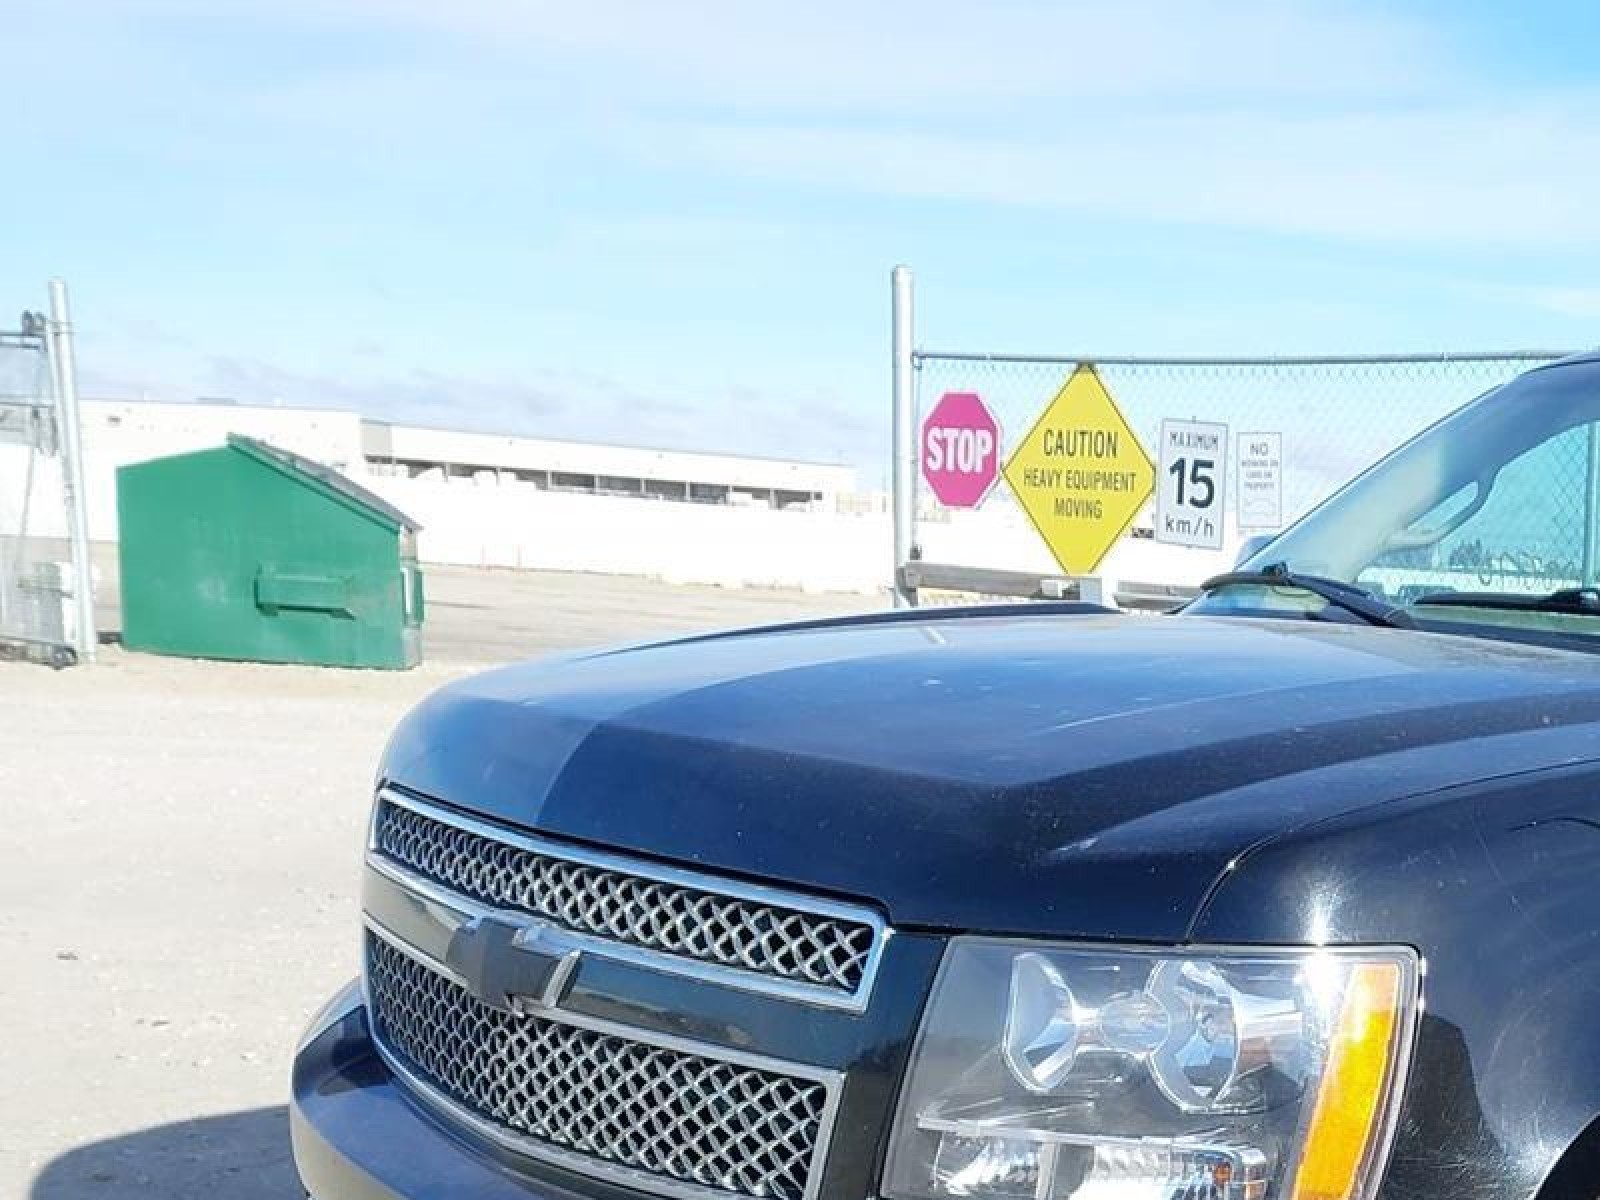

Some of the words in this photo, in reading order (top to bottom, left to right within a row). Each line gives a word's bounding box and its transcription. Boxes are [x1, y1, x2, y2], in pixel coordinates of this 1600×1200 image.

[926, 426, 993, 473] STOP
[1043, 429, 1118, 458] CAUTION
[1169, 431, 1218, 453] MAXIMUM
[1250, 442, 1269, 456] NO
[1023, 467, 1063, 489] HEAVY
[1065, 469, 1137, 492] EQUIPMENT
[1169, 457, 1215, 509] 15
[1054, 497, 1103, 520] MOVING
[1165, 512, 1215, 538] km/h
